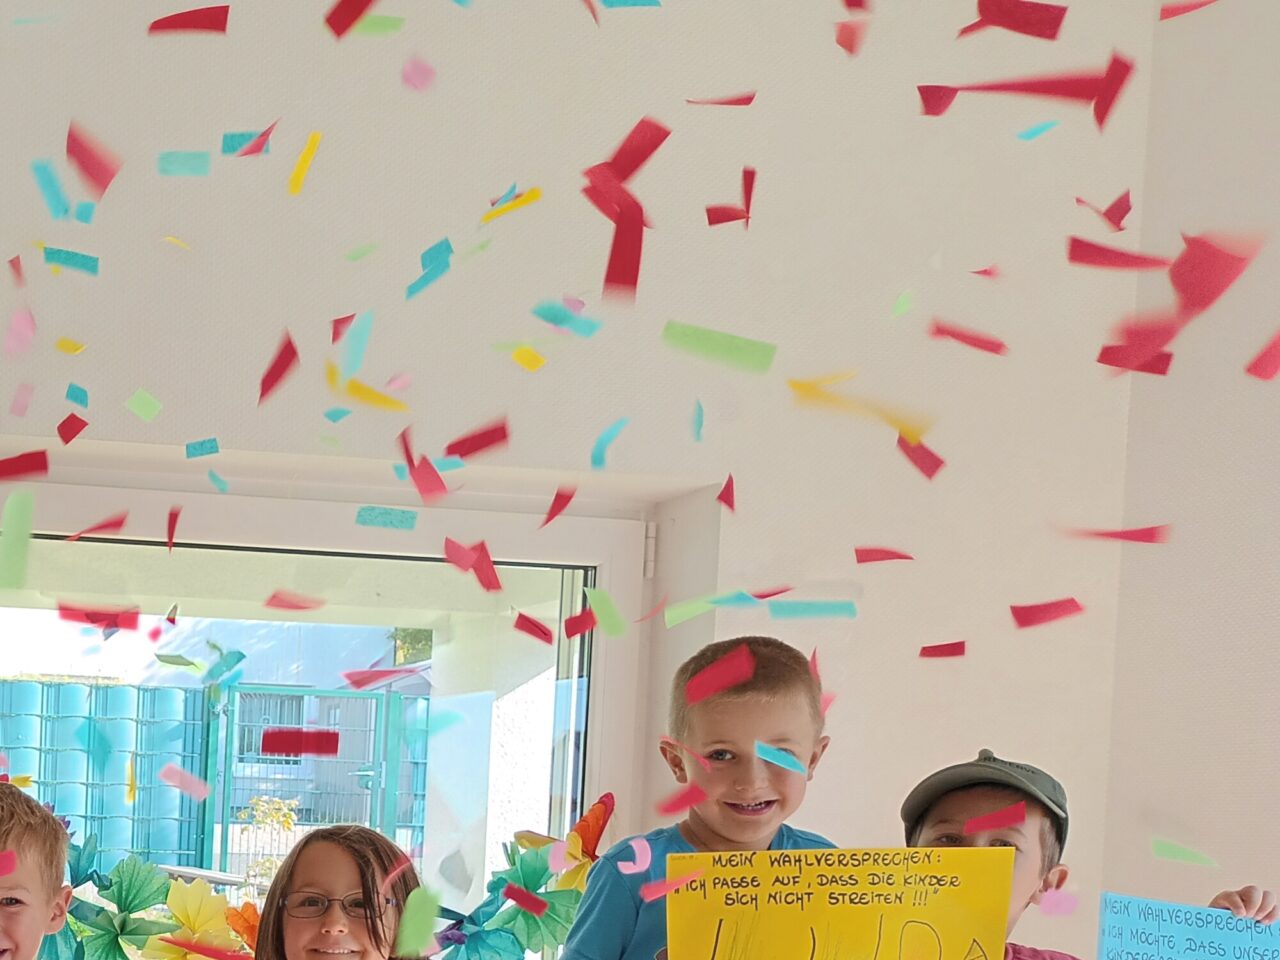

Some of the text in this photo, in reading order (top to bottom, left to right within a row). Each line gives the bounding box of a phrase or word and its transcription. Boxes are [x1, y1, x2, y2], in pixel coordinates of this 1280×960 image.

[712, 850, 941, 875] MEIN WAHLVERSPRECHEN:
[713, 876, 761, 890] PASSE
[816, 873, 859, 887] DASS
[867, 872, 896, 887] DIE
[903, 872, 962, 889] KINDER
[724, 891, 759, 911] SICH
[767, 891, 814, 911] NICHT
[1104, 897, 1132, 918] MEIN
[1183, 937, 1227, 957] DASS
